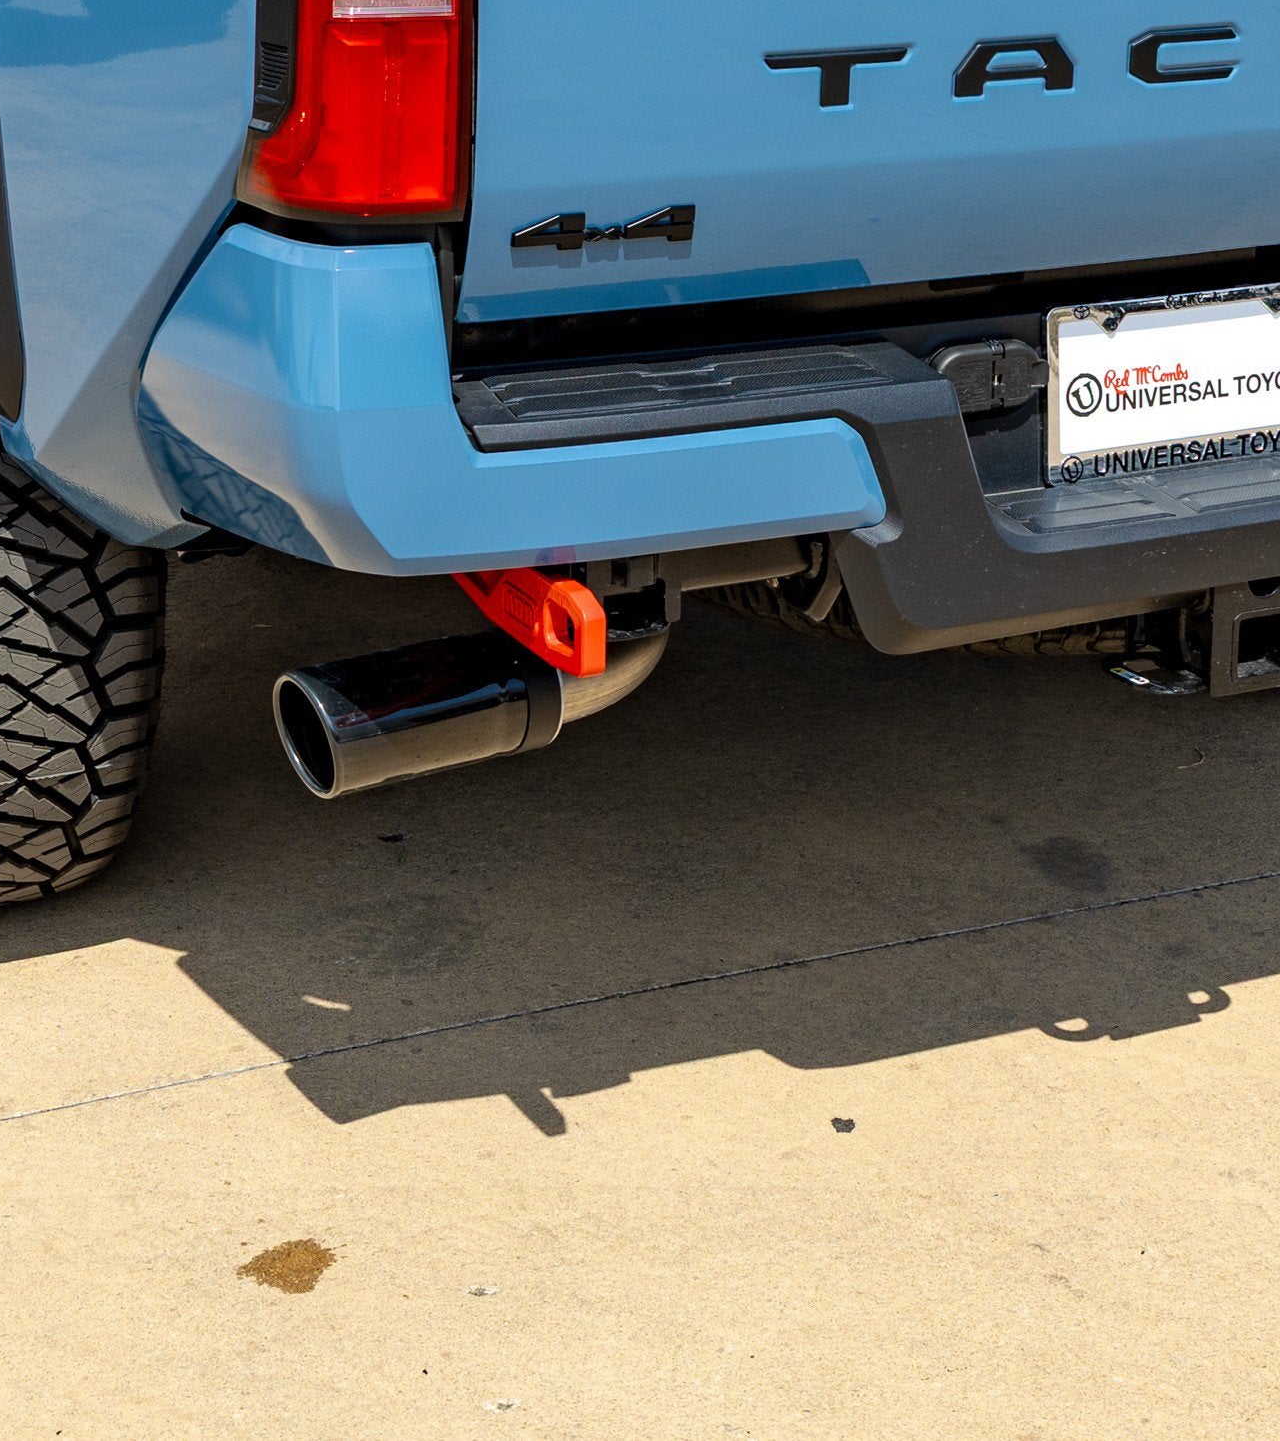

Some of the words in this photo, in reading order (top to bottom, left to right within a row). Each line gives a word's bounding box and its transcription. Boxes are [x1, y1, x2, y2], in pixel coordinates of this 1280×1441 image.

[1104, 369, 1129, 395] Red
[1105, 378, 1229, 412] UNIVERSAL
[1093, 437, 1233, 476] UNIVERSAL
